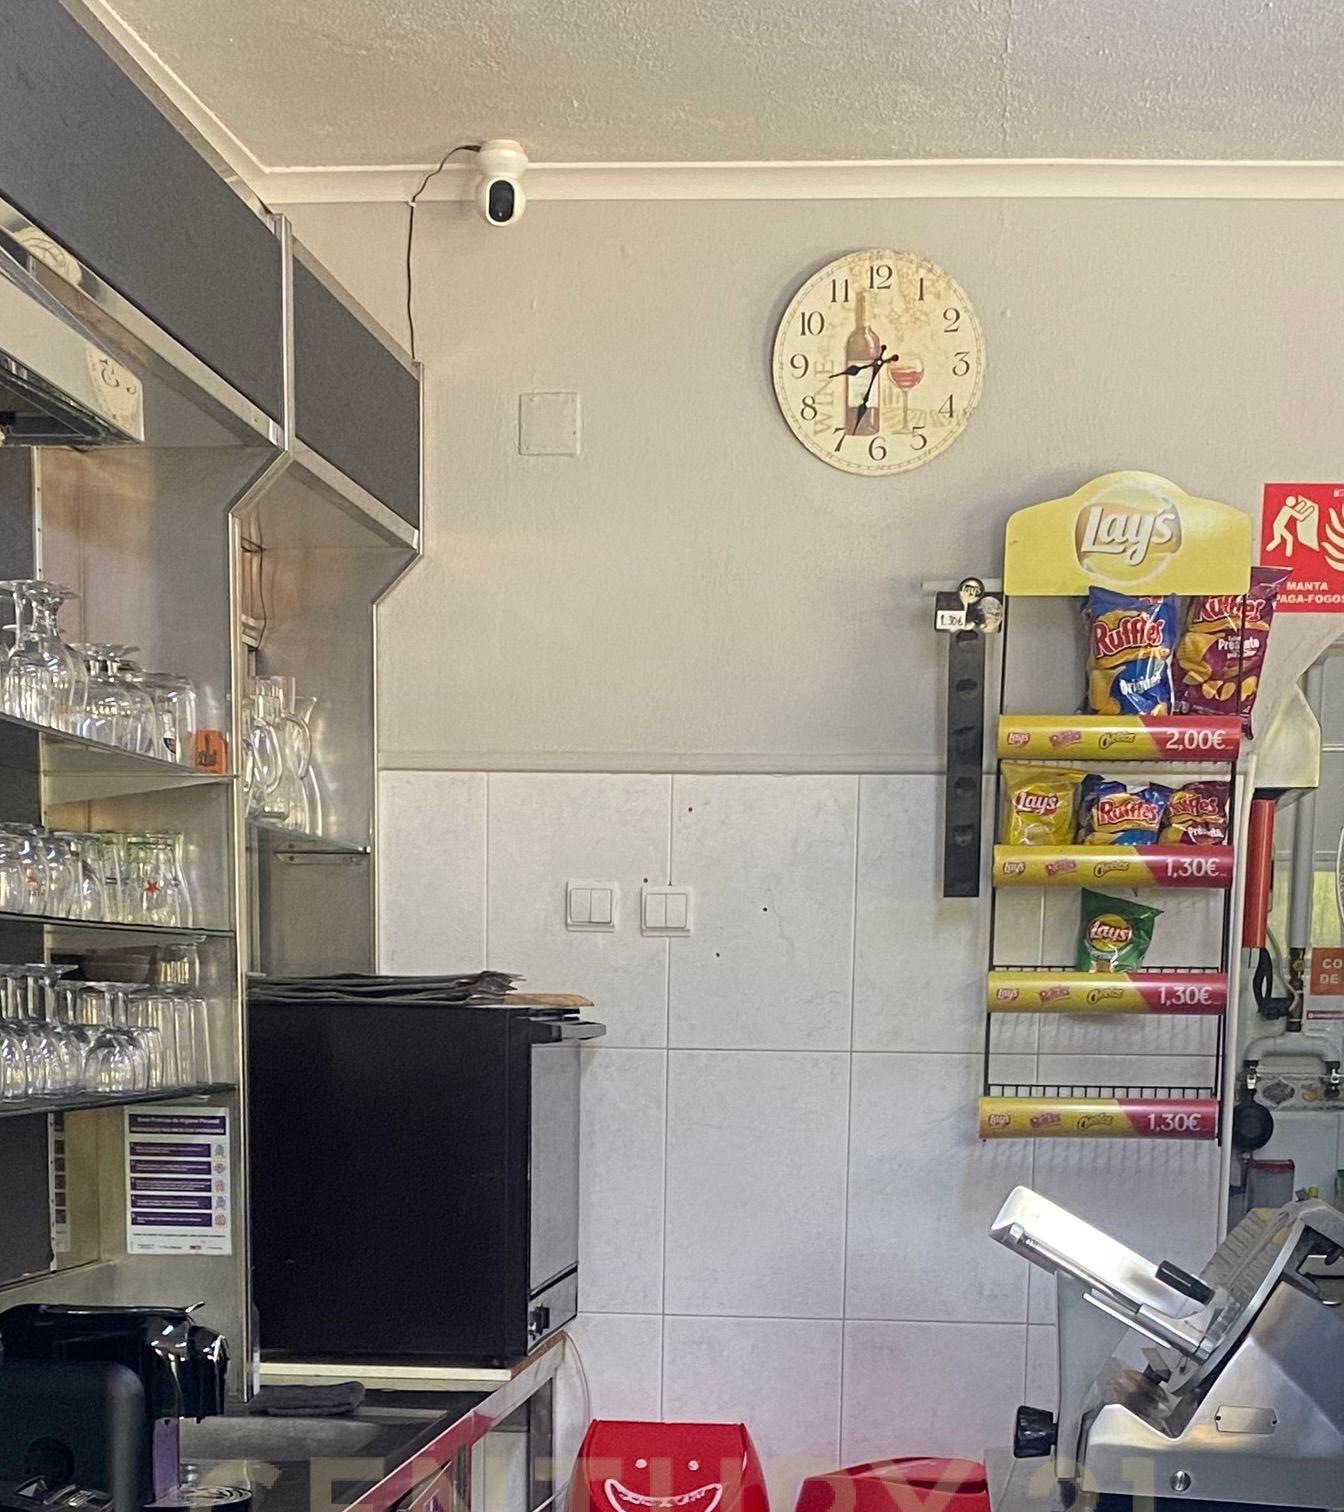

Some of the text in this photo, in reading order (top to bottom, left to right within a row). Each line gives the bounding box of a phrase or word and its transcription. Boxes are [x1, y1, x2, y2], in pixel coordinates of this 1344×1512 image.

[869, 264, 893, 290] 12
[917, 277, 925, 301] 1
[830, 278, 849, 303] 11
[799, 311, 826, 336] 10
[943, 307, 961, 333] 2
[790, 353, 810, 379] 9
[952, 351, 971, 377] 3
[800, 395, 818, 421] 8
[938, 394, 954, 419] 4
[832, 427, 848, 452] 7
[868, 436, 887, 461] 6
[910, 426, 928, 451] 5
[1081, 504, 1176, 566] Lay's
[1285, 581, 1329, 591] MANTA
[1165, 729, 1227, 751] 2,00€
[1164, 857, 1221, 878] 1,30€
[1319, 974, 1340, 984] DE
[1157, 986, 1213, 1006] 1,30€
